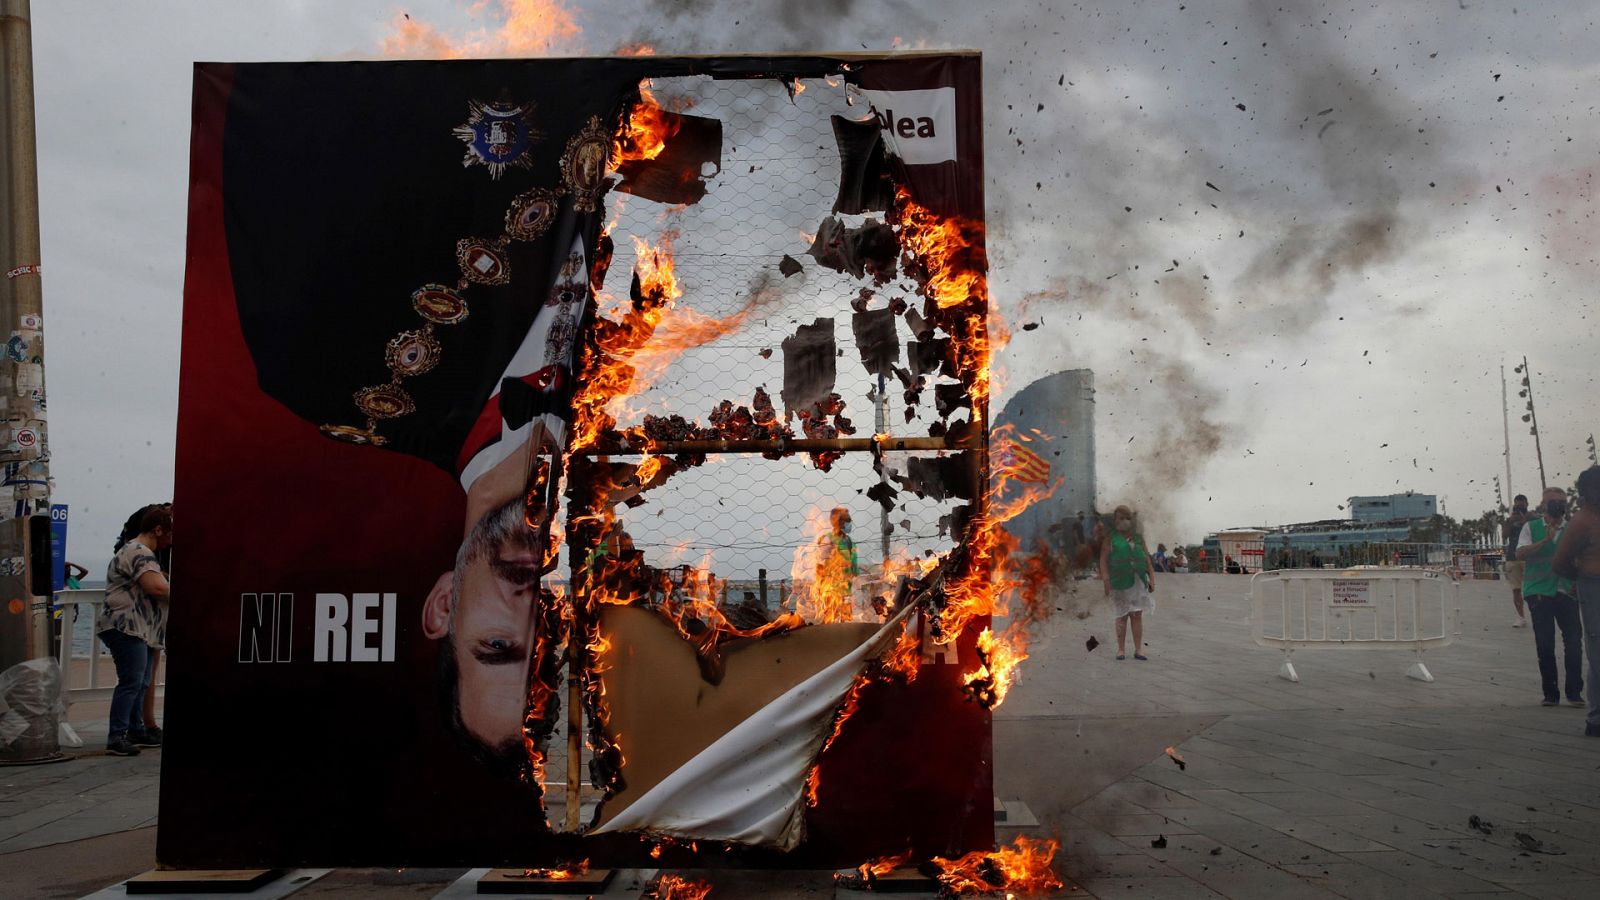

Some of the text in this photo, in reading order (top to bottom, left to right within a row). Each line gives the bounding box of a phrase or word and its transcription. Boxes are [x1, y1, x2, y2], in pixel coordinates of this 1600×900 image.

[51, 509, 67, 520] 06
[238, 592, 397, 663] NI REI
